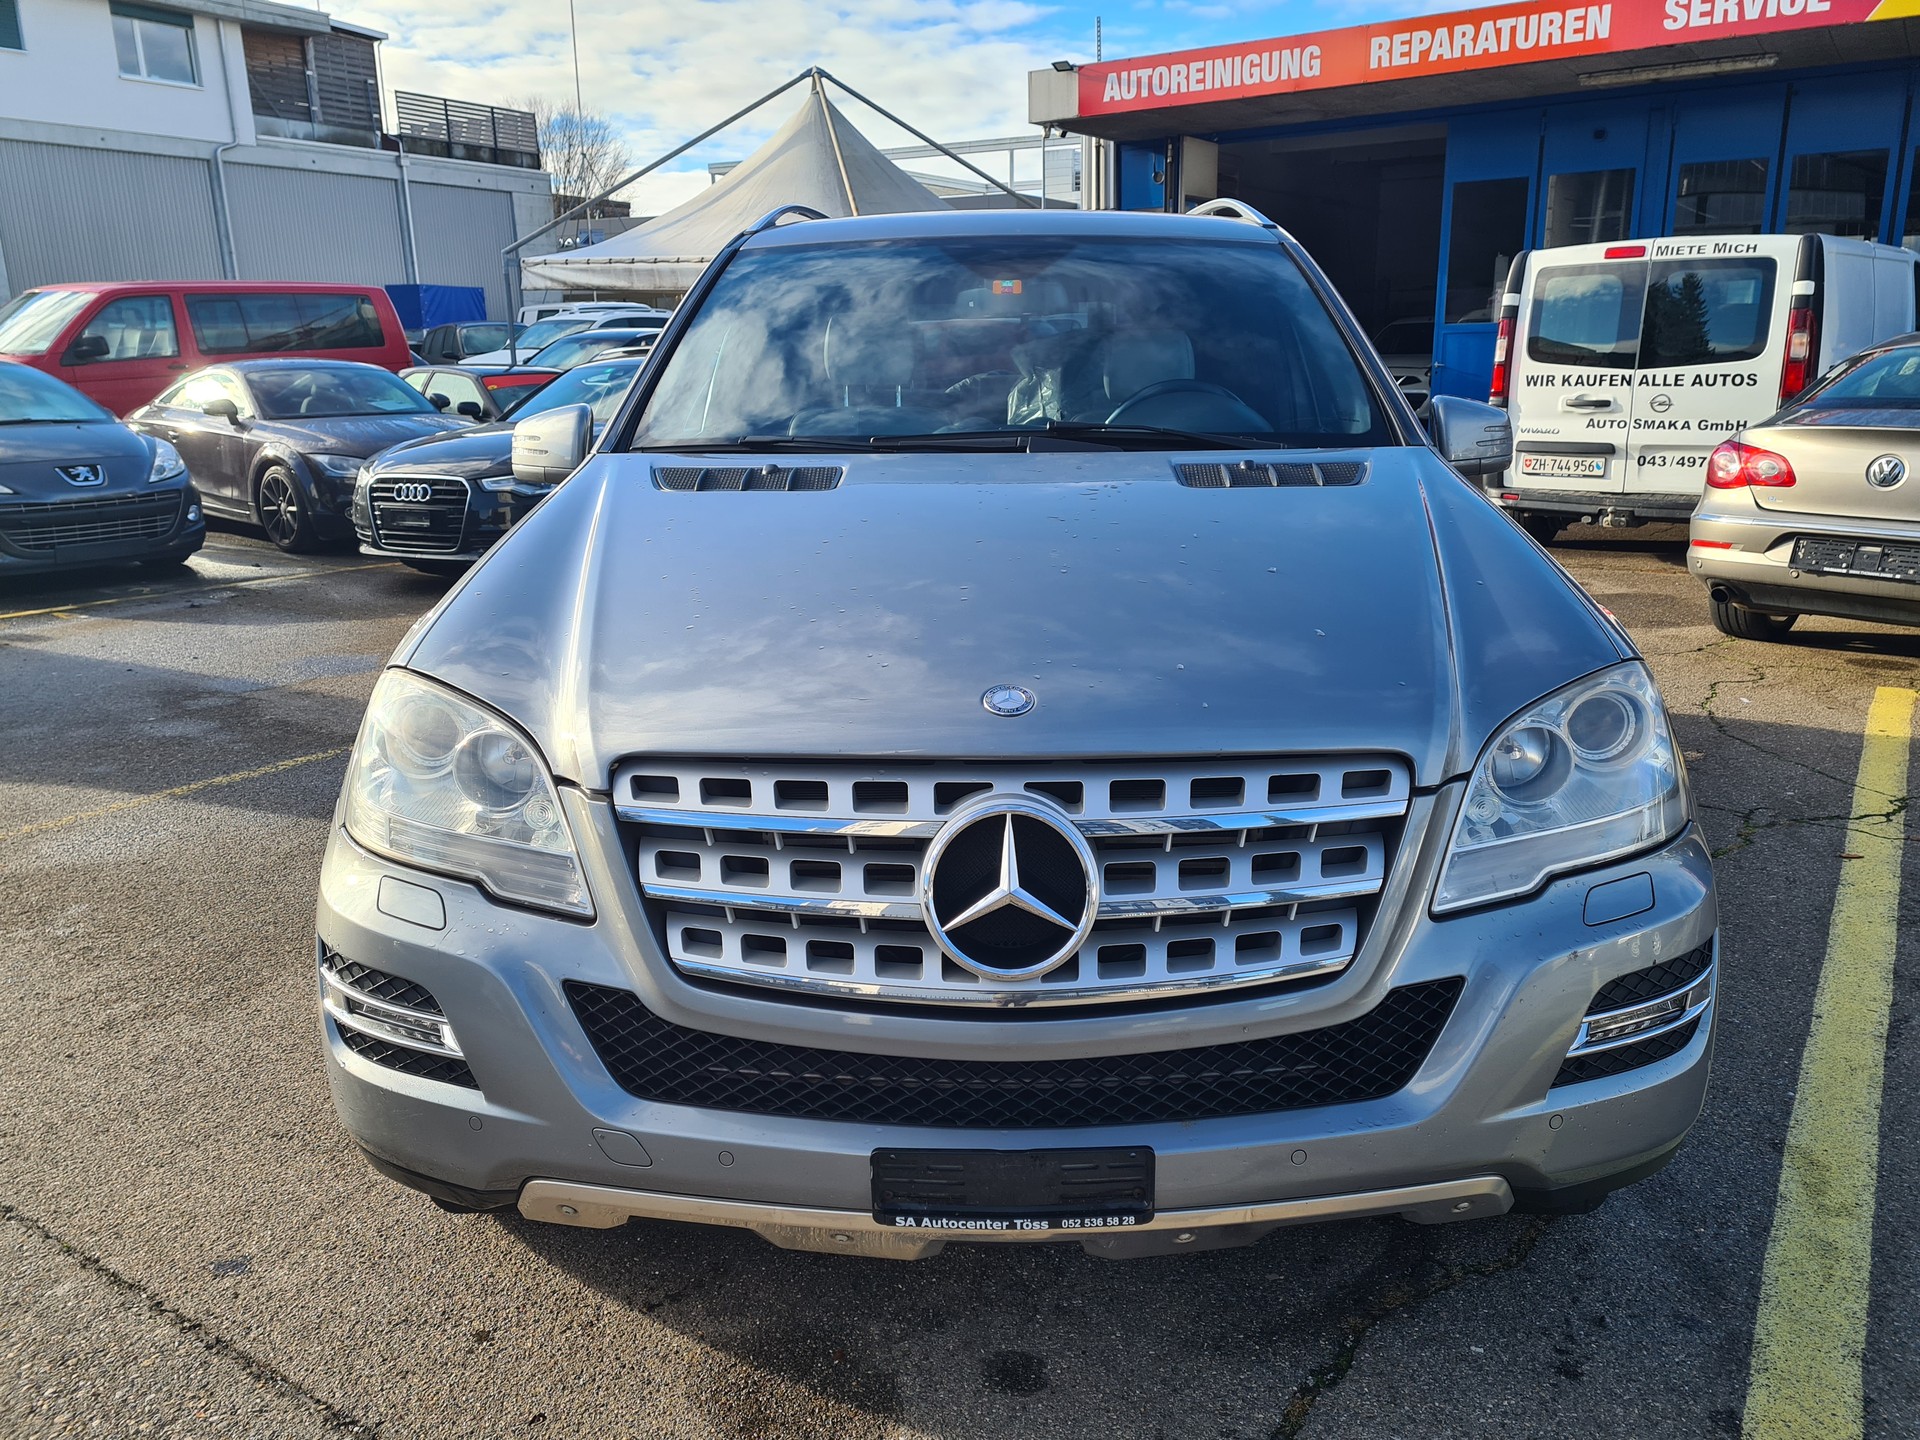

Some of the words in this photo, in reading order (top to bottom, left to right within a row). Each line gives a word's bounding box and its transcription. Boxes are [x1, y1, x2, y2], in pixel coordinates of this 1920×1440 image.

[1102, 45, 1322, 102] AUTOREINIGUNG
[1369, 4, 1612, 69] REPARATUREN
[1655, 244, 1707, 257] MIETE
[1712, 242, 1758, 255] MICH
[1525, 374, 1556, 387] WIR
[1561, 374, 1632, 388] KAUFEN
[1637, 374, 1686, 387] ALLE
[1690, 373, 1759, 387] AUTOS
[1585, 418, 1628, 430] AUTO
[1632, 418, 1692, 431] SMAKA
[1697, 419, 1748, 432] GmbH
[895, 1216, 917, 1228] SA
[921, 1216, 1009, 1230] Autocenter
[1014, 1218, 1049, 1230] Töss
[1061, 1218, 1081, 1229] 052
[1084, 1217, 1104, 1228] 536
[1106, 1216, 1120, 1227] 58
[1122, 1215, 1136, 1226] 28
